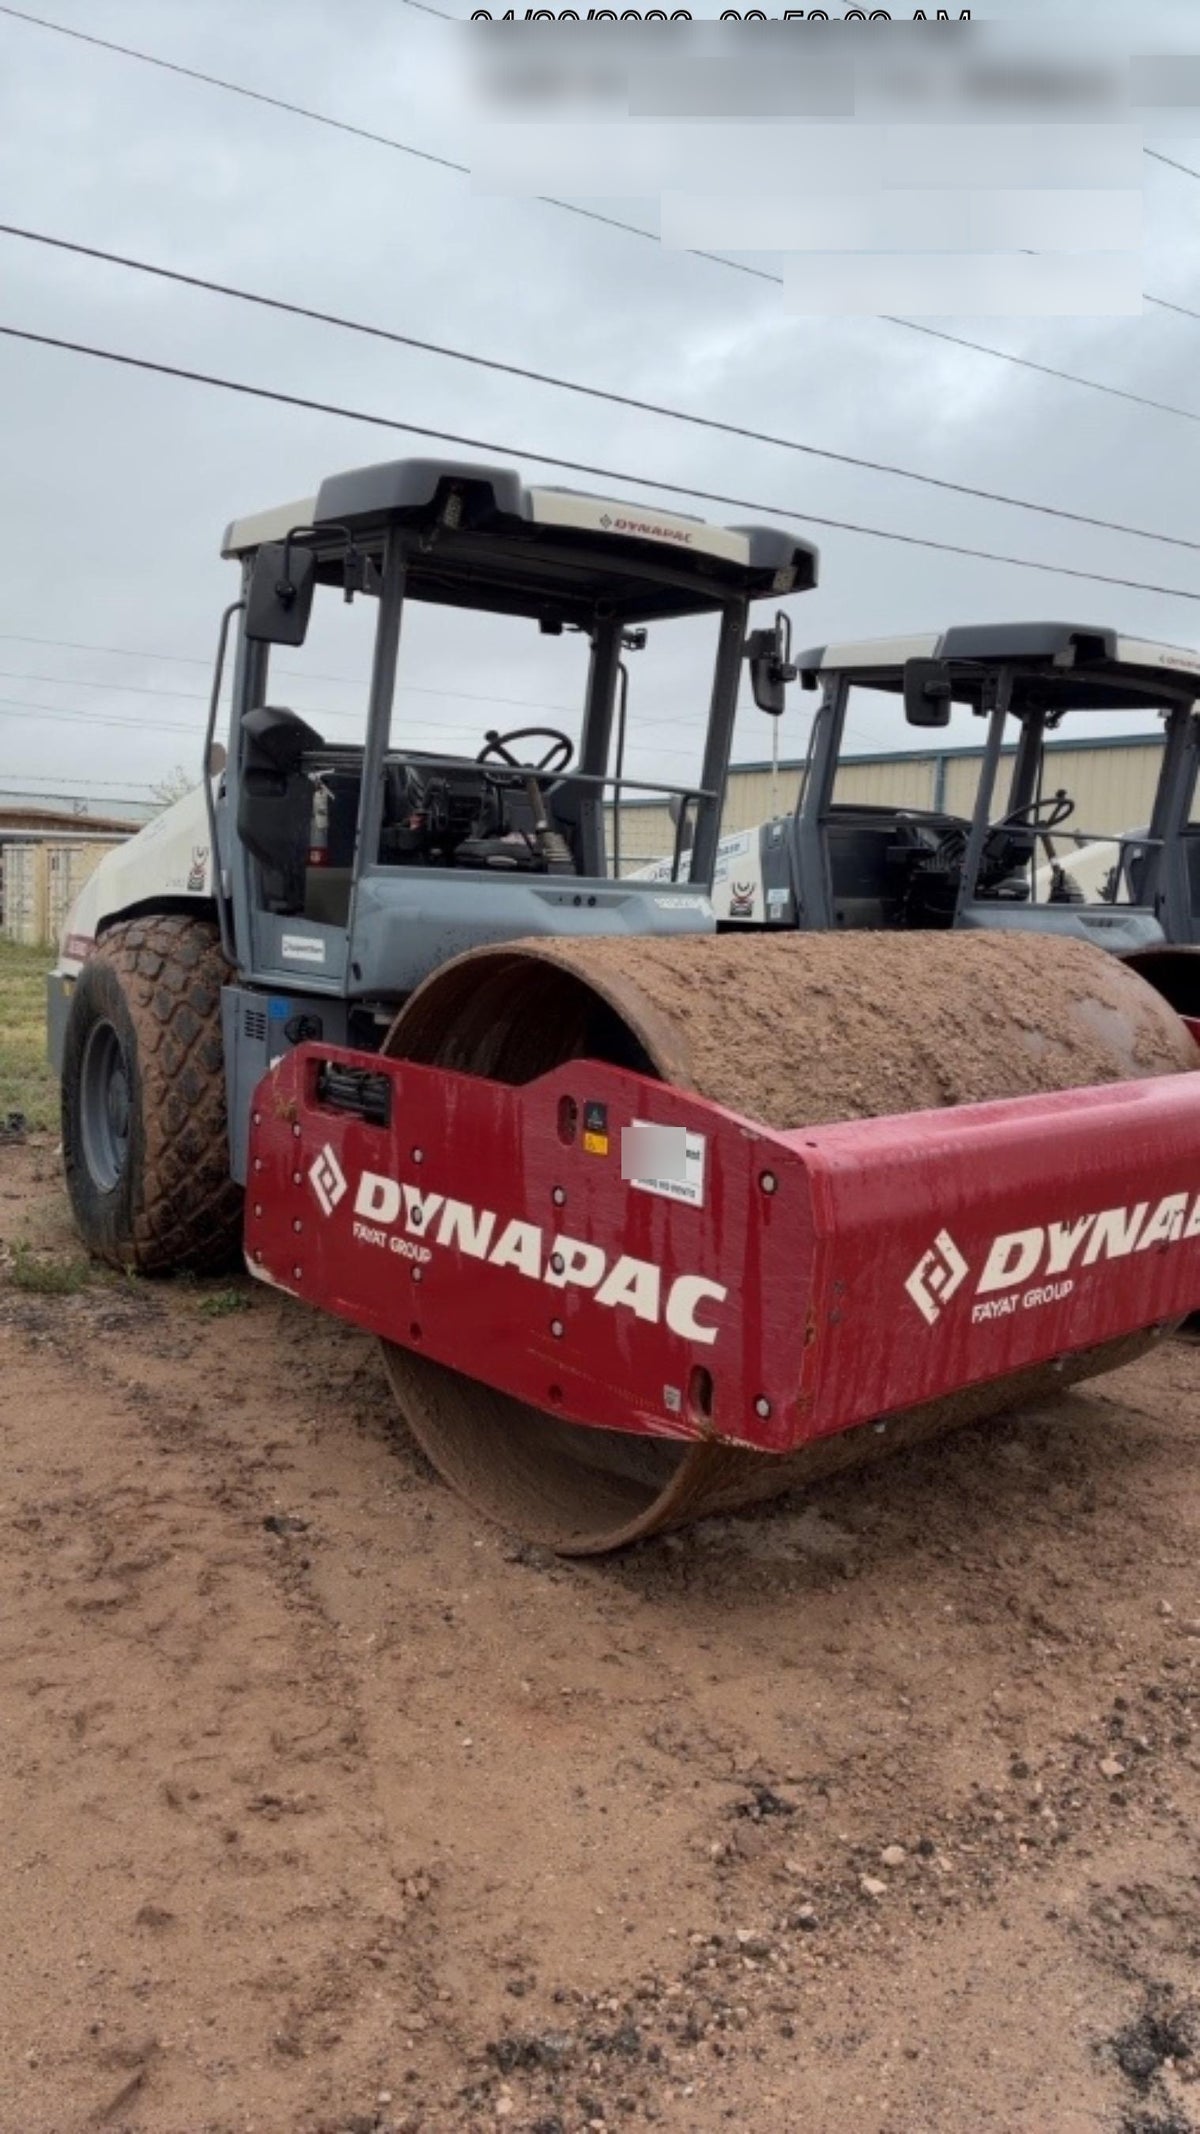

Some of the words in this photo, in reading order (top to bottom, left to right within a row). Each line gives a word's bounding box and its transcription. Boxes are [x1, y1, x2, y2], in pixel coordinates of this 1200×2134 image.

[614, 518, 692, 542] DYNAPAC
[352, 1220, 388, 1249] FAYAT
[389, 1236, 433, 1265] GROUP
[353, 1170, 728, 1345] DYNAPAC
[975, 1191, 1200, 1295] DYNA
[972, 1293, 1020, 1324] FAYAT
[1023, 1279, 1074, 1308] GROUP
